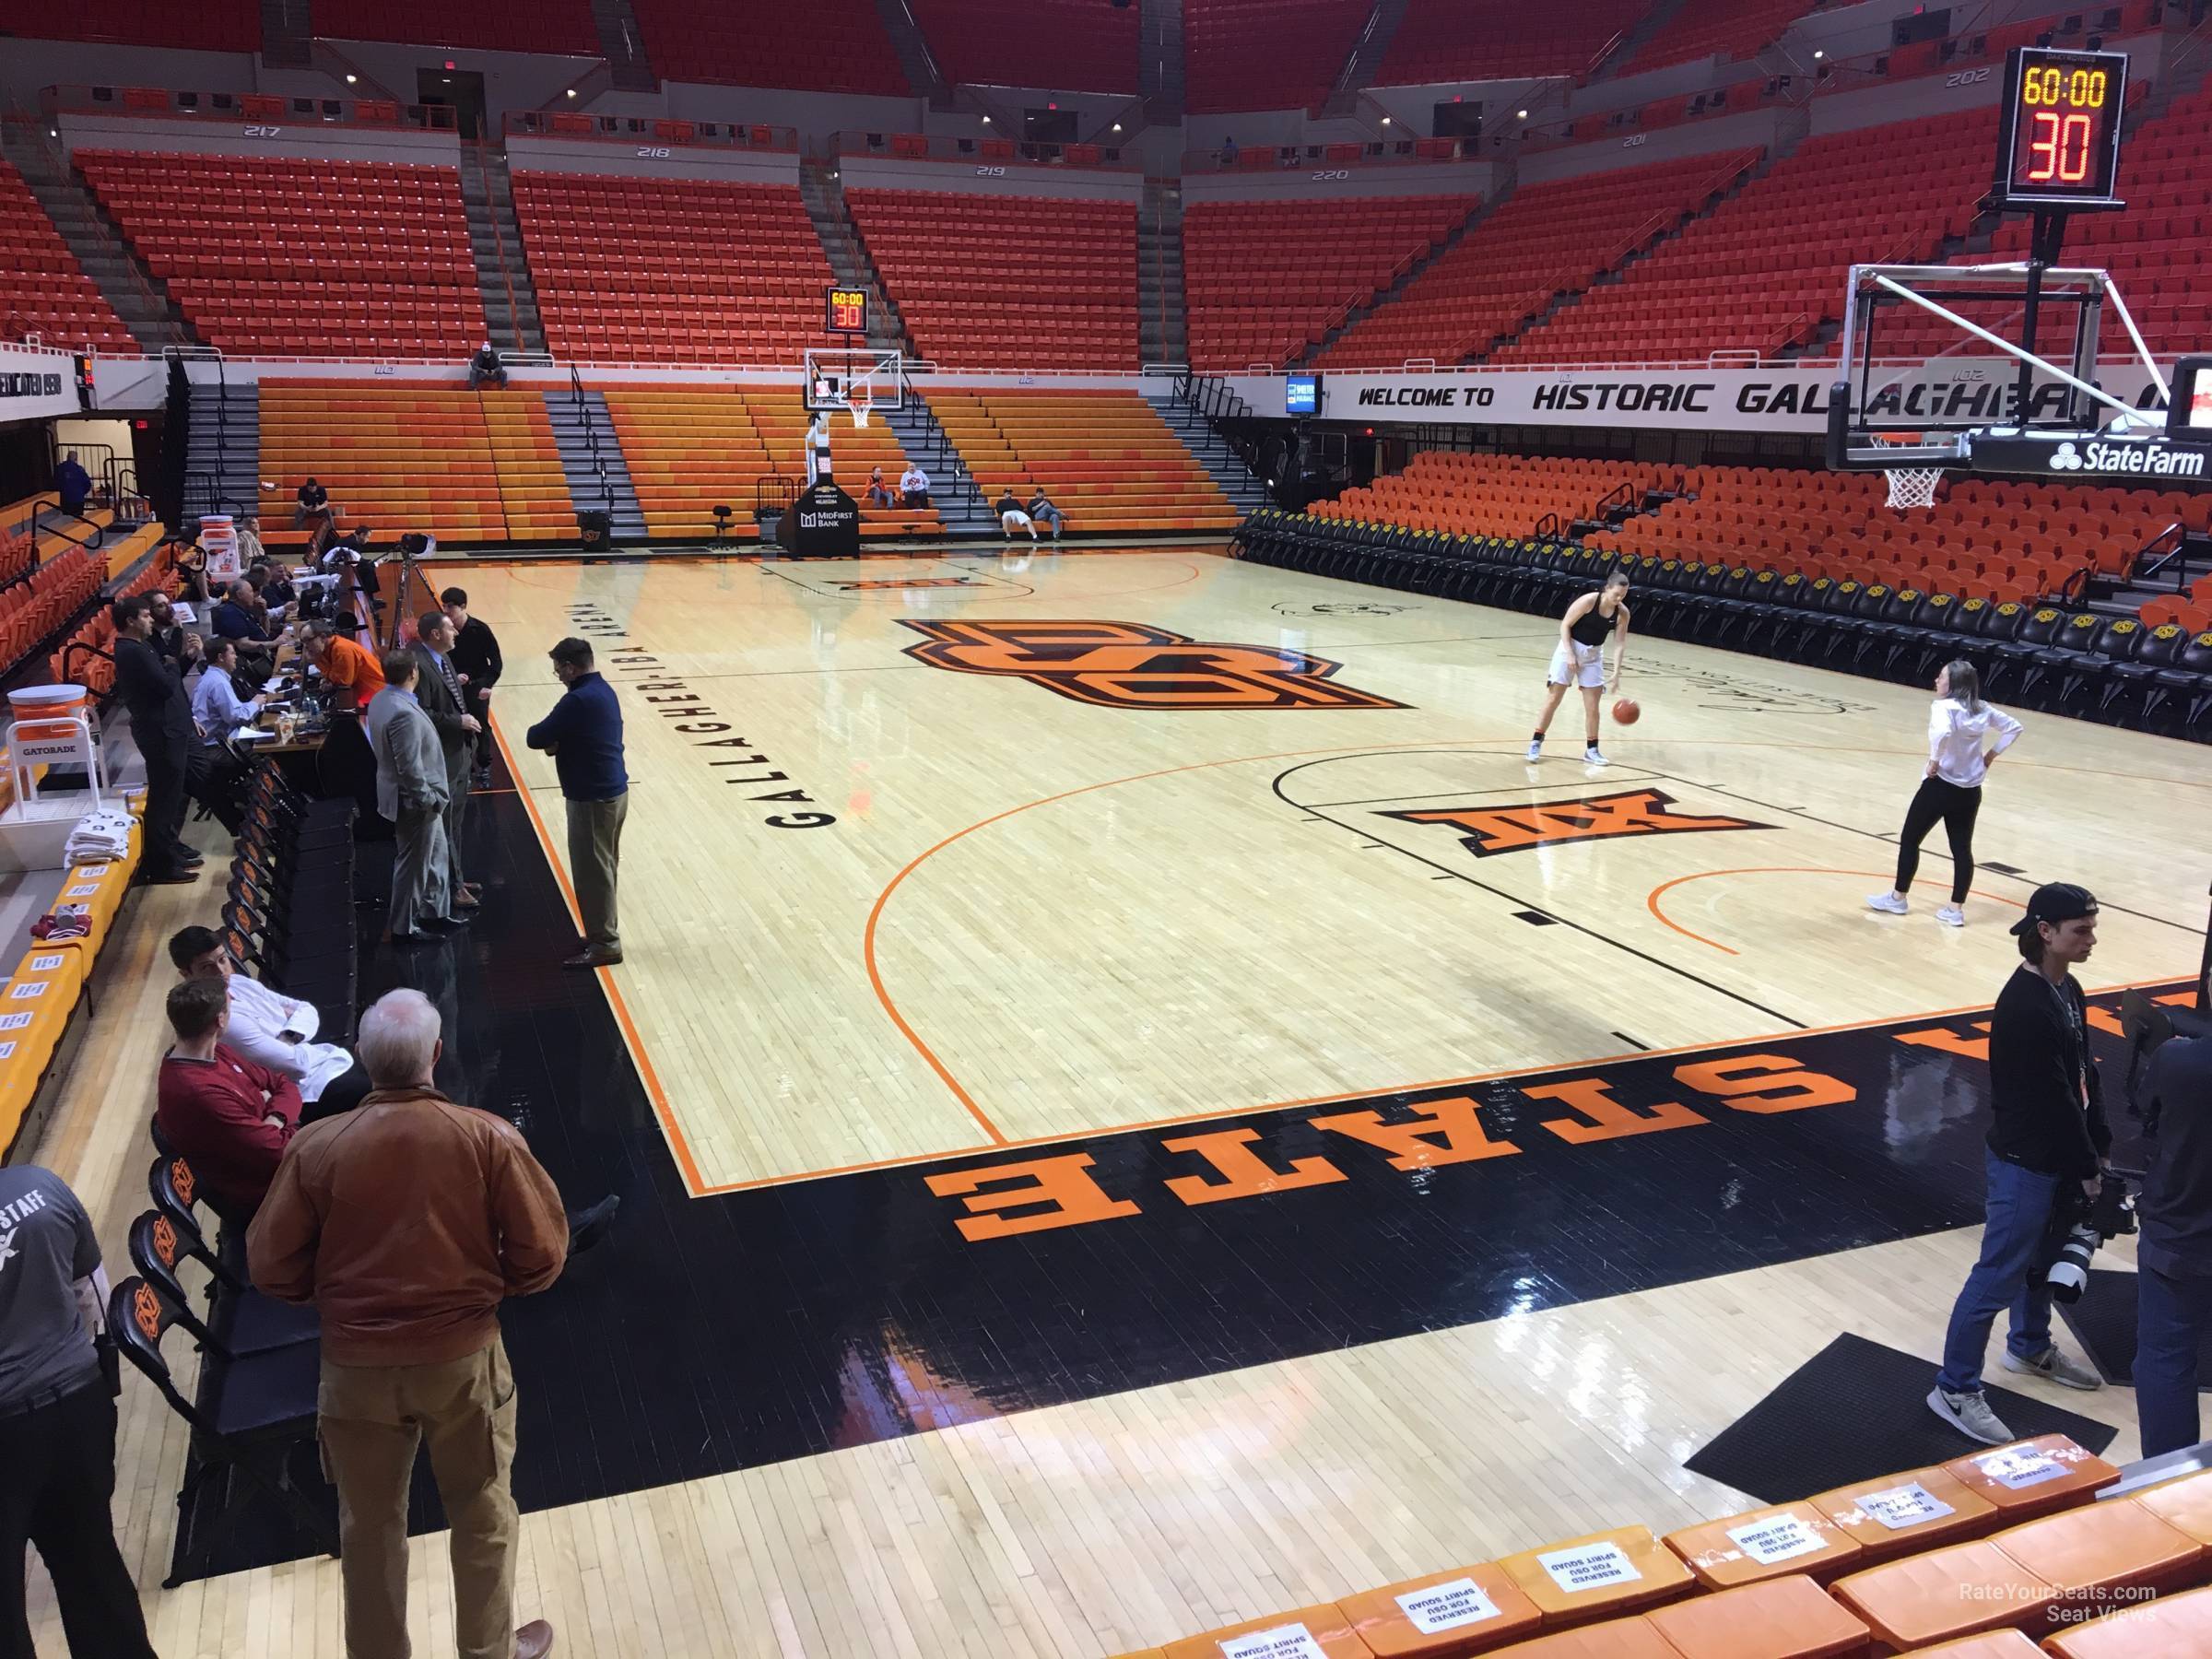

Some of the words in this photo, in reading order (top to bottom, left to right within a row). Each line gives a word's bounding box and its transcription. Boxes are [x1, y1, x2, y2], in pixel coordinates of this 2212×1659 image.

[1946, 67, 1991, 88] 202
[2024, 66, 2106, 108] 60:00
[243, 125, 280, 137] 217
[637, 147, 670, 158] 218
[2028, 112, 2091, 181] 30
[976, 166, 1005, 176] 219
[1312, 170, 1349, 181] 220
[831, 292, 864, 305] 60:00
[837, 305, 859, 326] 30
[1952, 369, 1984, 382] 102
[1359, 387, 1457, 406] WELCOME
[1464, 388, 1495, 406] TO
[1533, 382, 1716, 413] HISTORIC
[818, 520, 840, 528] BANK
[560, 603, 630, 638] ARENA
[23, 745, 76, 757] GATORADE
[923, 1053, 1858, 1242] STATE
[0, 1189, 47, 1230] STAFF
[1550, 1558, 1585, 1571] SQUAD
[1586, 1552, 1618, 1565] SPIRIT
[1569, 1567, 1591, 1577] OSU
[1591, 1562, 1612, 1571] FOR
[1571, 1568, 1623, 1584] RESERVED
[1444, 1587, 1476, 1602] SPIRIT
[1407, 1596, 1442, 1611] SQUAD
[1450, 1598, 1471, 1610] FOR
[1426, 1605, 1449, 1616] OSU
[1429, 1605, 1481, 1623] RESERVED
[1273, 1635, 1307, 1650] SPIRIT
[1233, 1643, 1271, 1659] SQUAD
[1277, 1646, 1300, 1657] FOR
